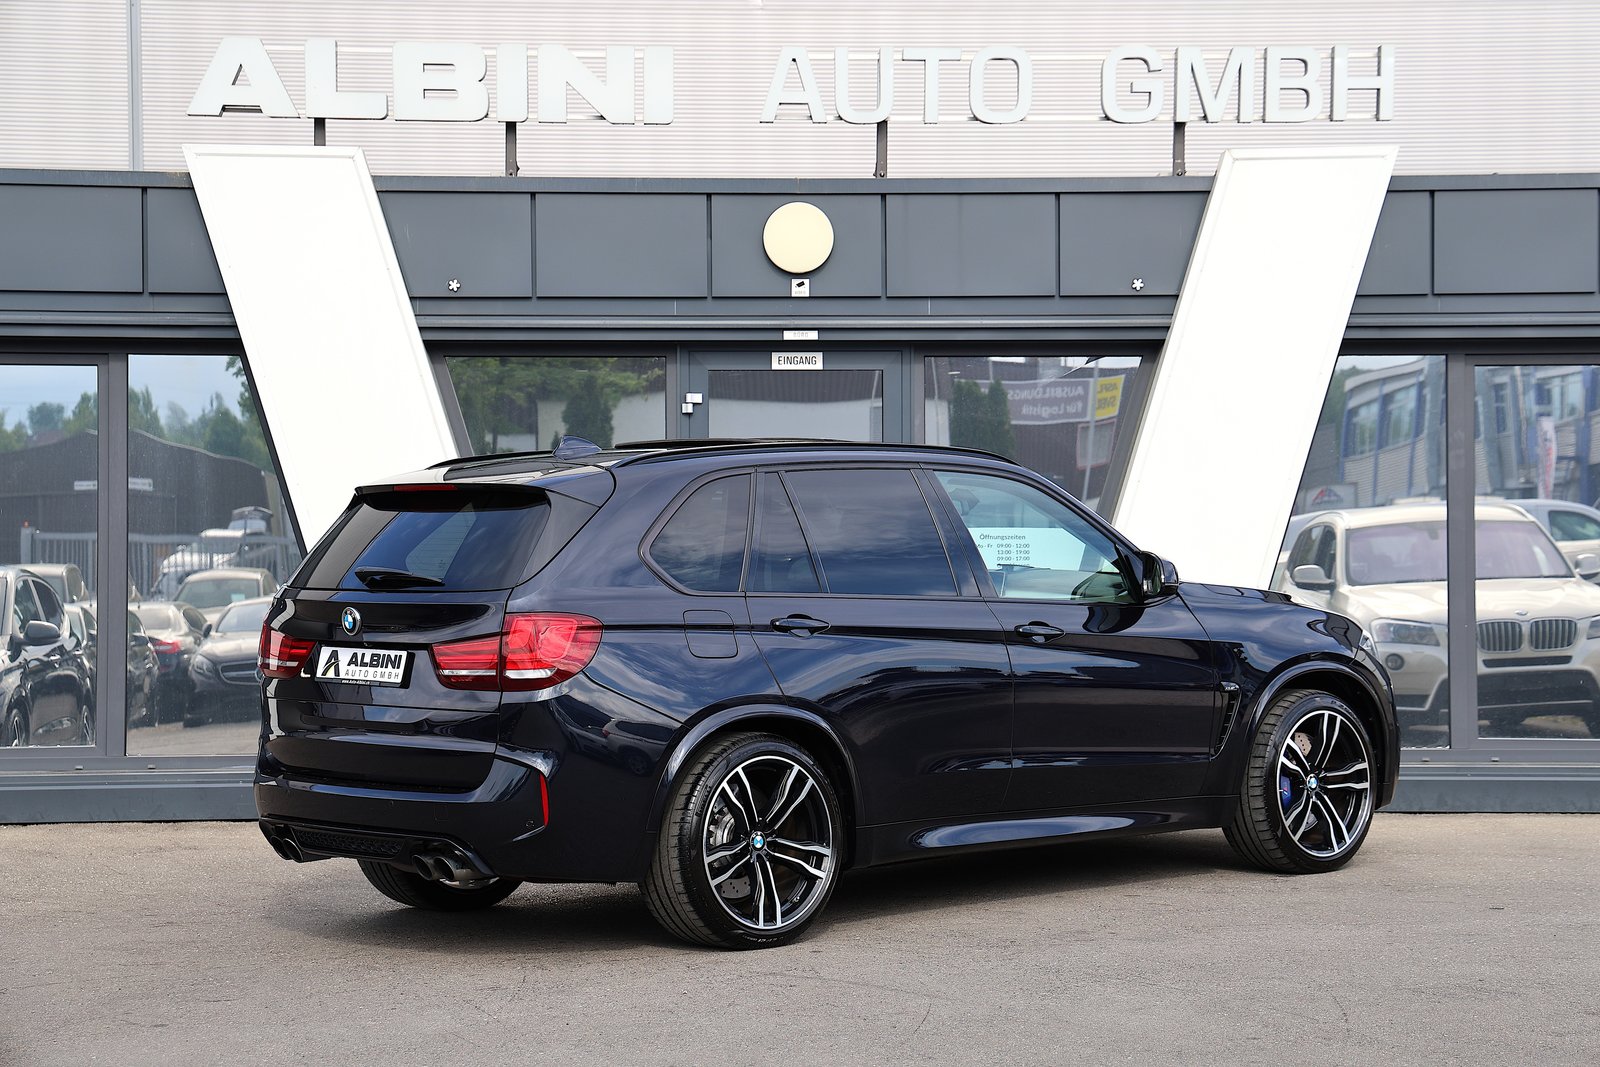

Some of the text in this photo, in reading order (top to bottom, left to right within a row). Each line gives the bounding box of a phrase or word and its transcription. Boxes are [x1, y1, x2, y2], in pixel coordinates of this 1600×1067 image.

[187, 37, 1395, 125] ALBINI AUTO GMBH
[777, 355, 817, 365] EINGANG
[347, 652, 403, 669] ALBINI
[345, 669, 400, 680] AUTO GMBH
